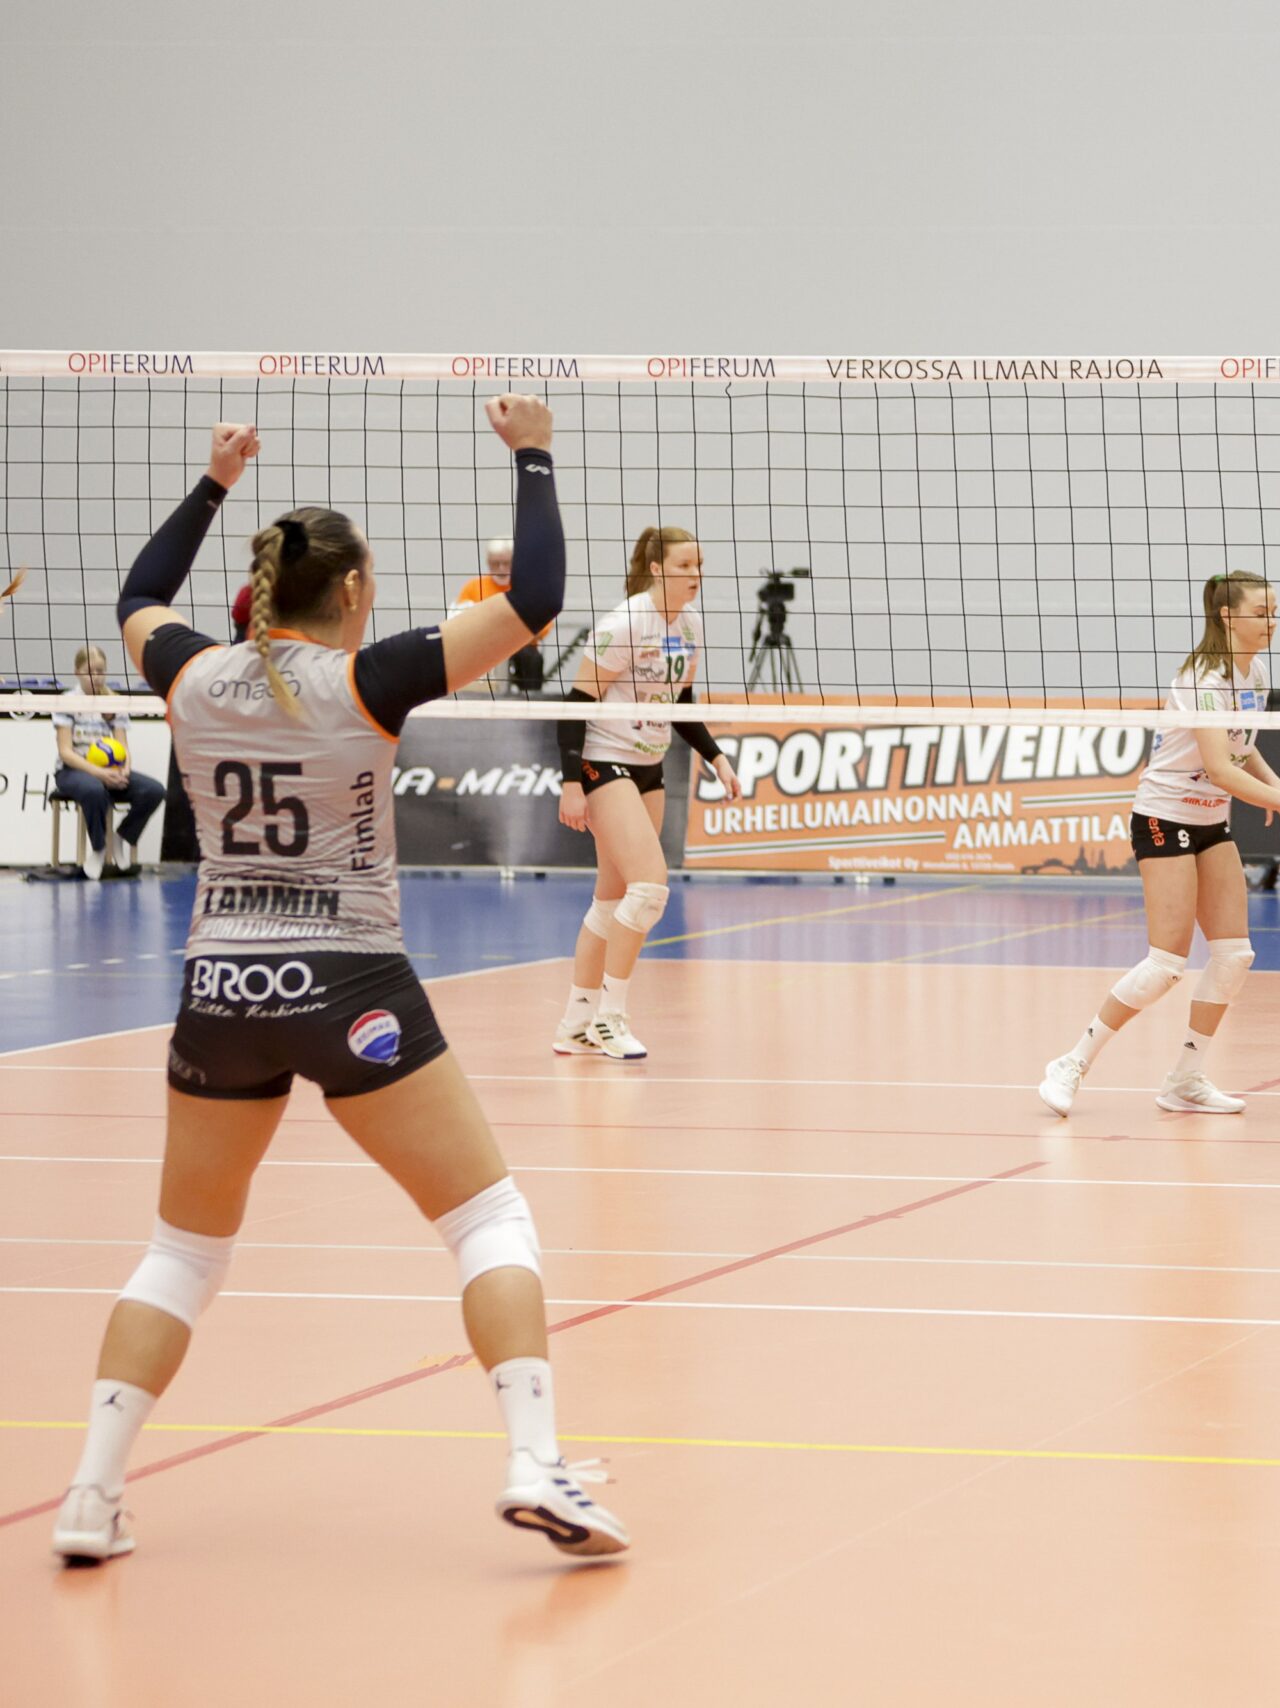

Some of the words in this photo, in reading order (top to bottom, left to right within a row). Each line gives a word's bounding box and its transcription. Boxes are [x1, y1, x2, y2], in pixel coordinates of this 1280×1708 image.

[68, 352, 194, 375] OPIFERUM
[259, 355, 385, 377] OPIFERUM
[452, 356, 579, 378] OPIFERUM
[646, 357, 776, 379] OPIFERUM
[826, 358, 963, 380] VERKOSSA
[973, 358, 1058, 380] ILMAN
[1070, 358, 1163, 380] RAJOJA
[664, 654, 685, 685] 19
[213, 760, 310, 858] 25
[350, 769, 375, 873] Fimlab
[703, 792, 1013, 837] URHEILUMAINONNAN
[952, 813, 1132, 850] AMMATTILA
[191, 958, 314, 1003] BROO
